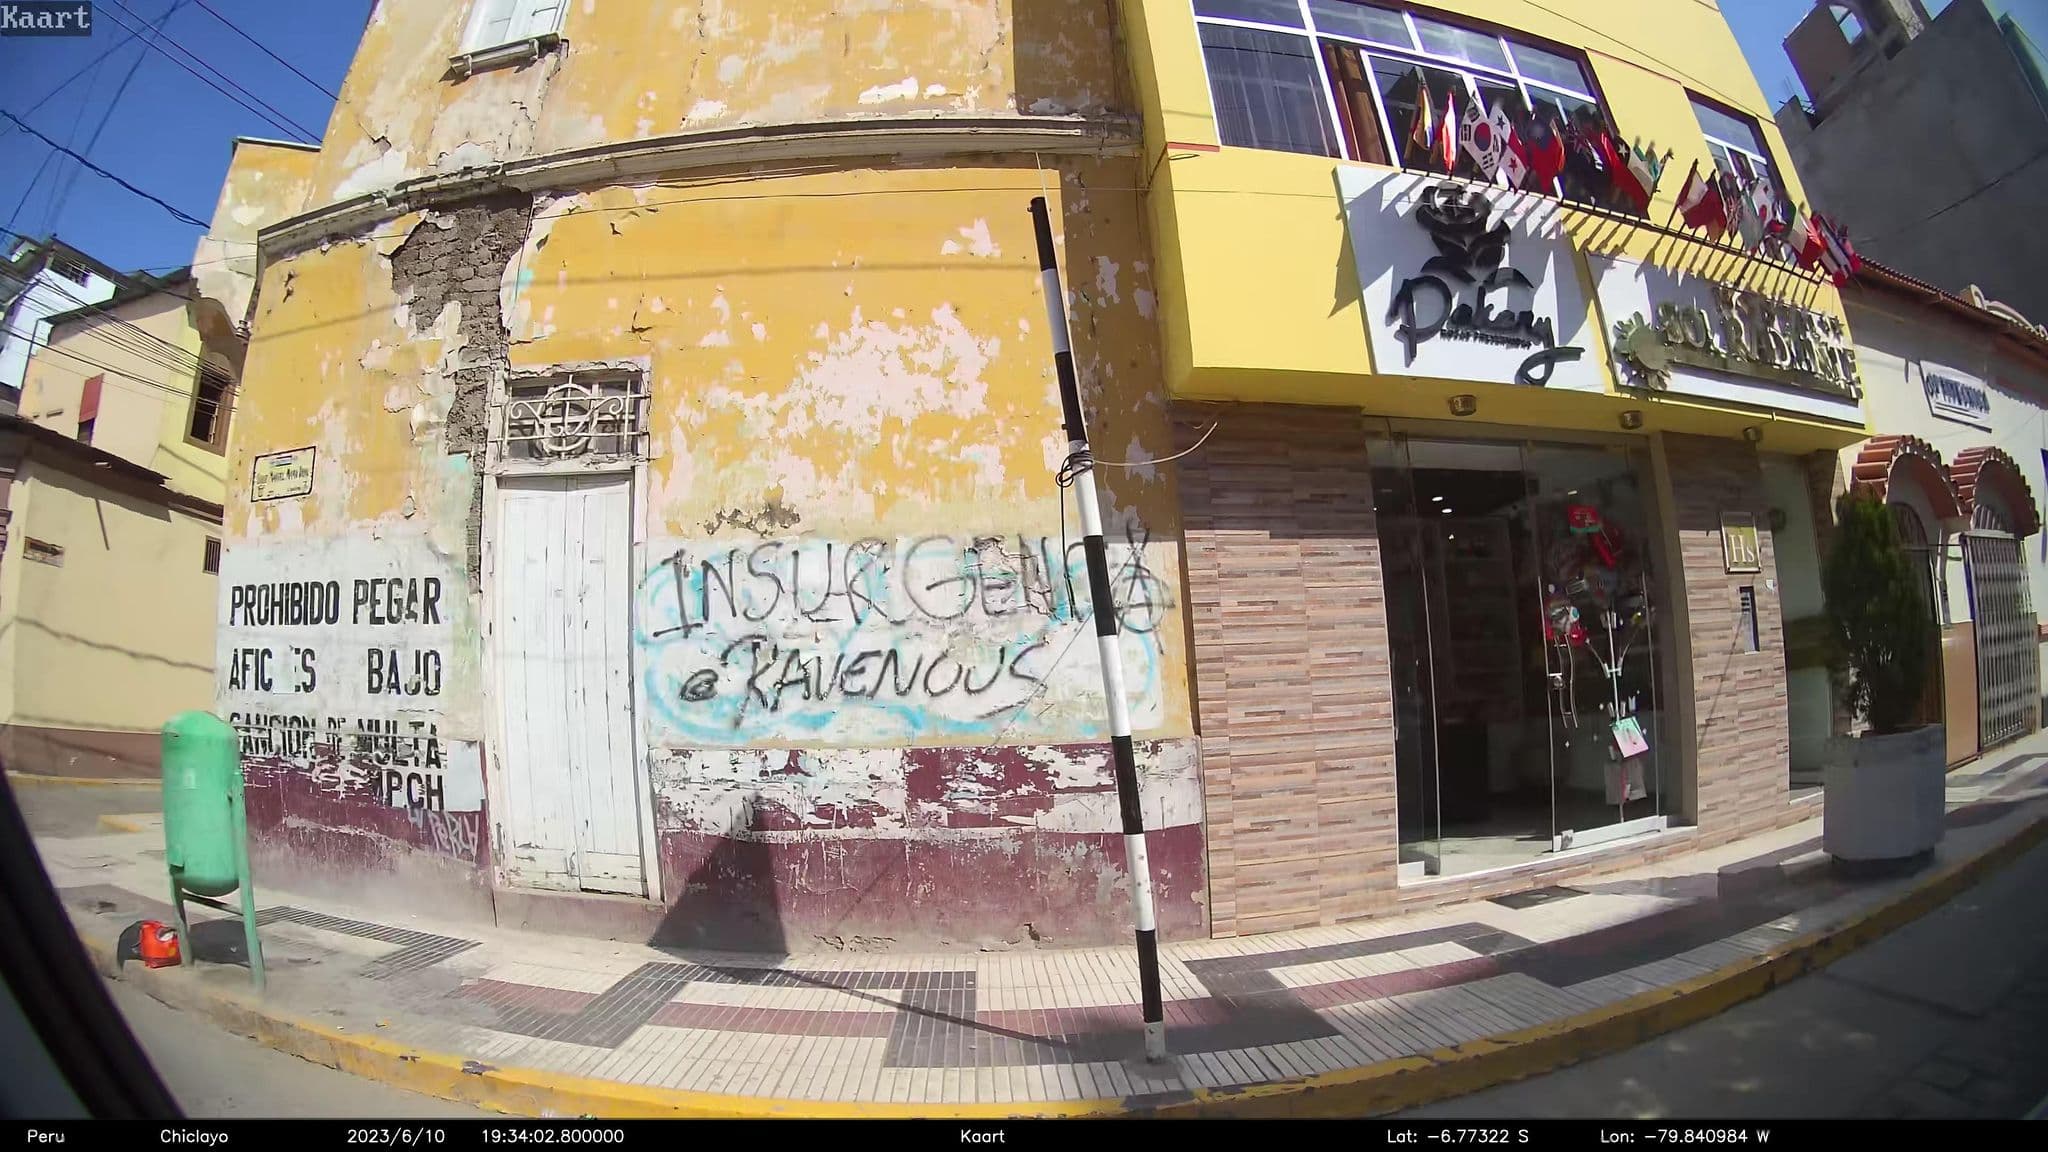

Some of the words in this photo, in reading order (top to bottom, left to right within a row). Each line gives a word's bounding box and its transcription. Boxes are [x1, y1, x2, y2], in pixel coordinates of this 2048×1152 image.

[1729, 534, 1755, 563] Hs
[229, 580, 340, 626] PROHIBIDO
[352, 577, 441, 625] PEGAR
[228, 647, 317, 692] AFICS
[366, 648, 442, 696] BAJO
